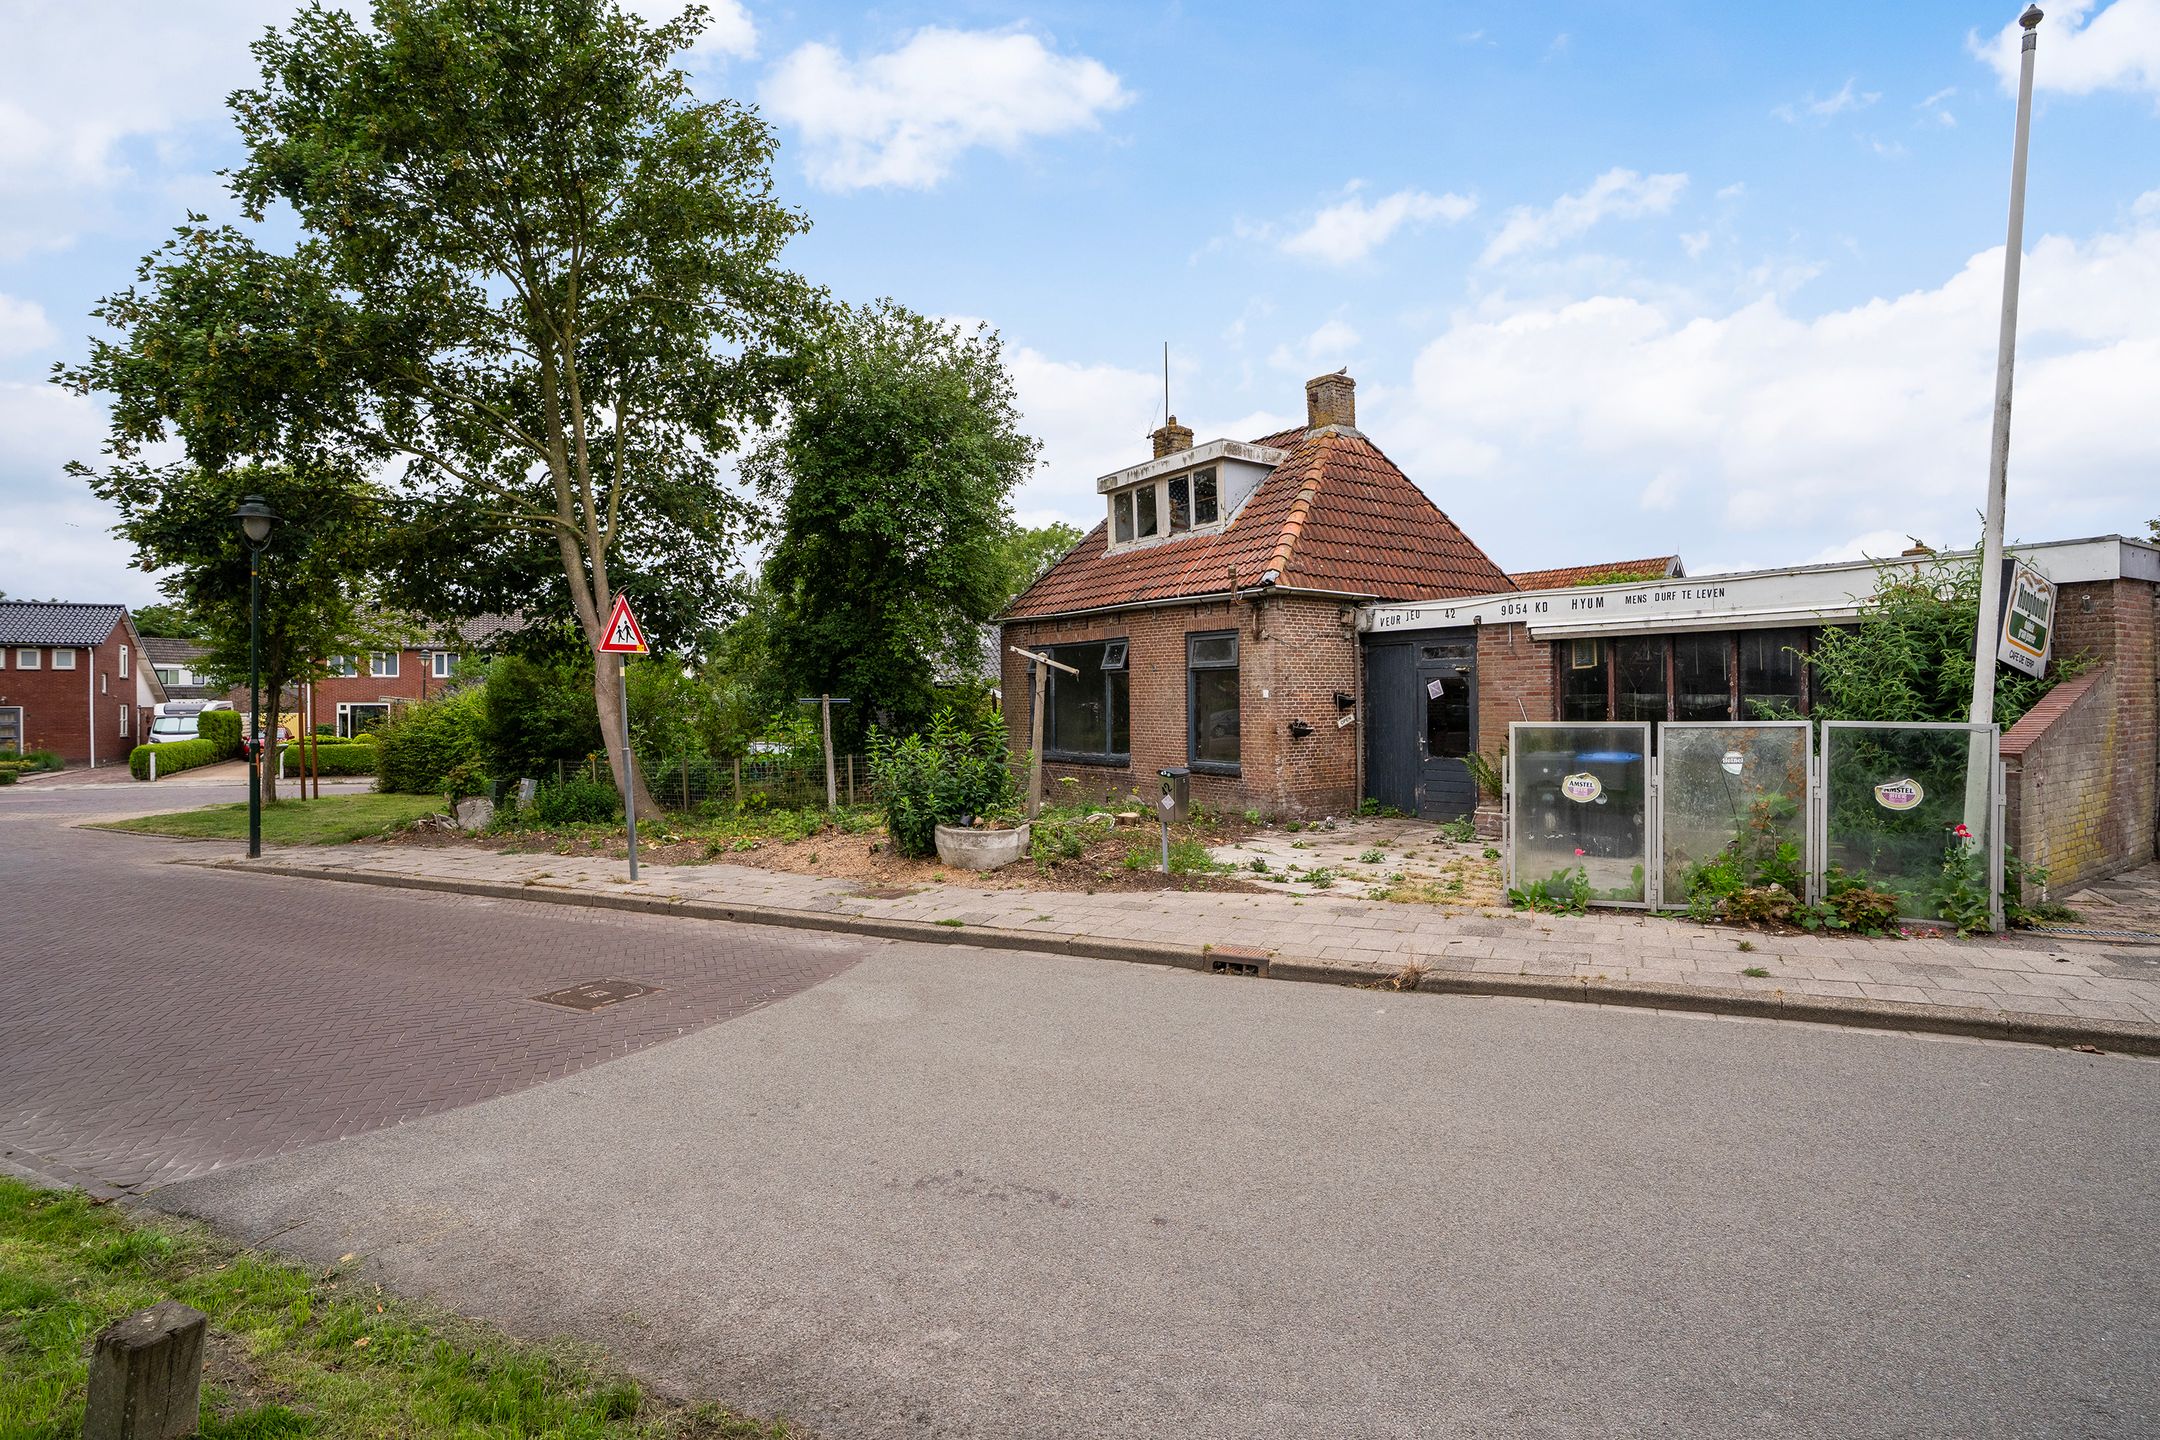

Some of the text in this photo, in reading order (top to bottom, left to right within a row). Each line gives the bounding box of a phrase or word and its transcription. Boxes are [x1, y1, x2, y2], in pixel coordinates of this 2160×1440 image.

[1625, 587, 1725, 605] MENS DURF TE LEVEN
[1501, 603, 1528, 616] 9054
[1571, 597, 1604, 610] HYUM
[1380, 615, 1401, 627] VEUR
[1445, 608, 1456, 619] 42
[1340, 716, 1352, 725] OPEN
[1161, 782, 1173, 796] 42
[1569, 780, 1593, 788] AMSTEL
